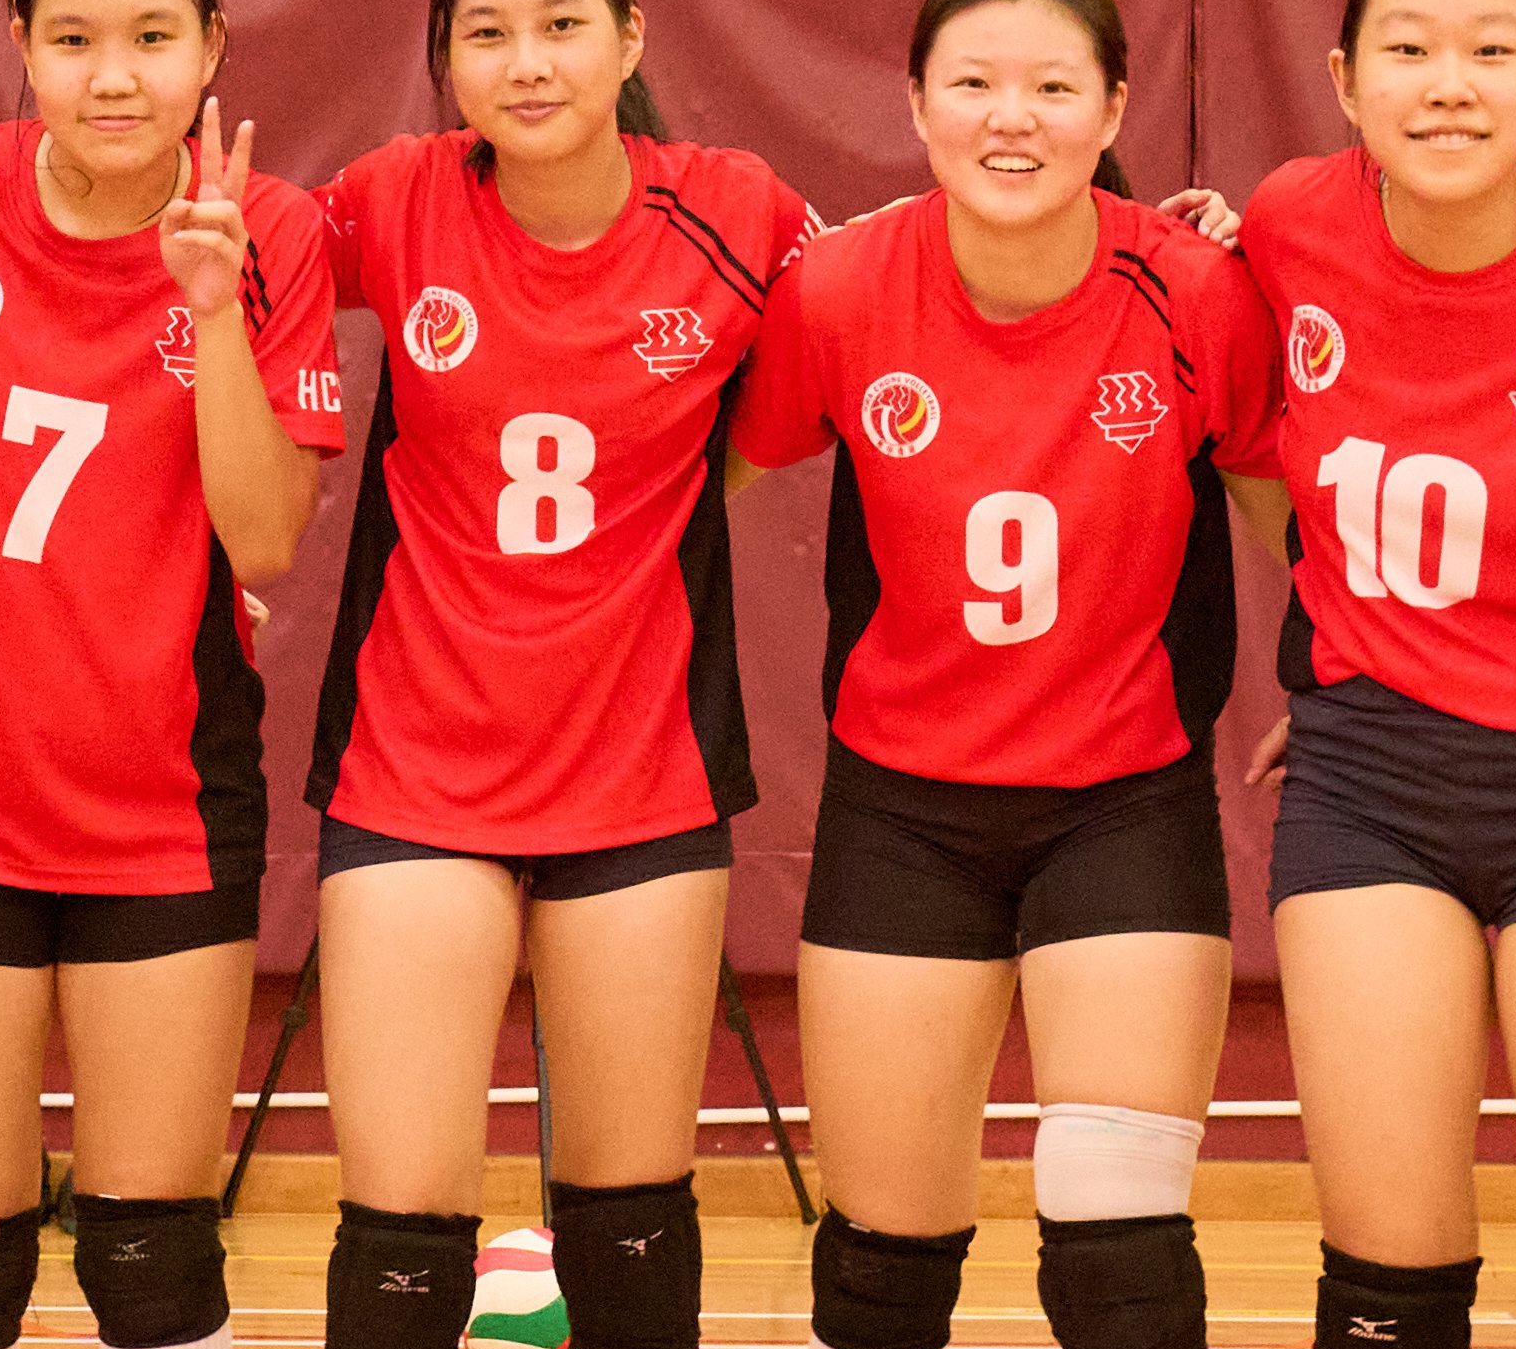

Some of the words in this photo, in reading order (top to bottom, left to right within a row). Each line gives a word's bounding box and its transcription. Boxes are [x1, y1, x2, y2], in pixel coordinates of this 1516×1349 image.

[2, 386, 108, 563] 7
[497, 413, 595, 554] 8
[1317, 437, 1487, 609] 10
[964, 491, 1058, 645] 9
